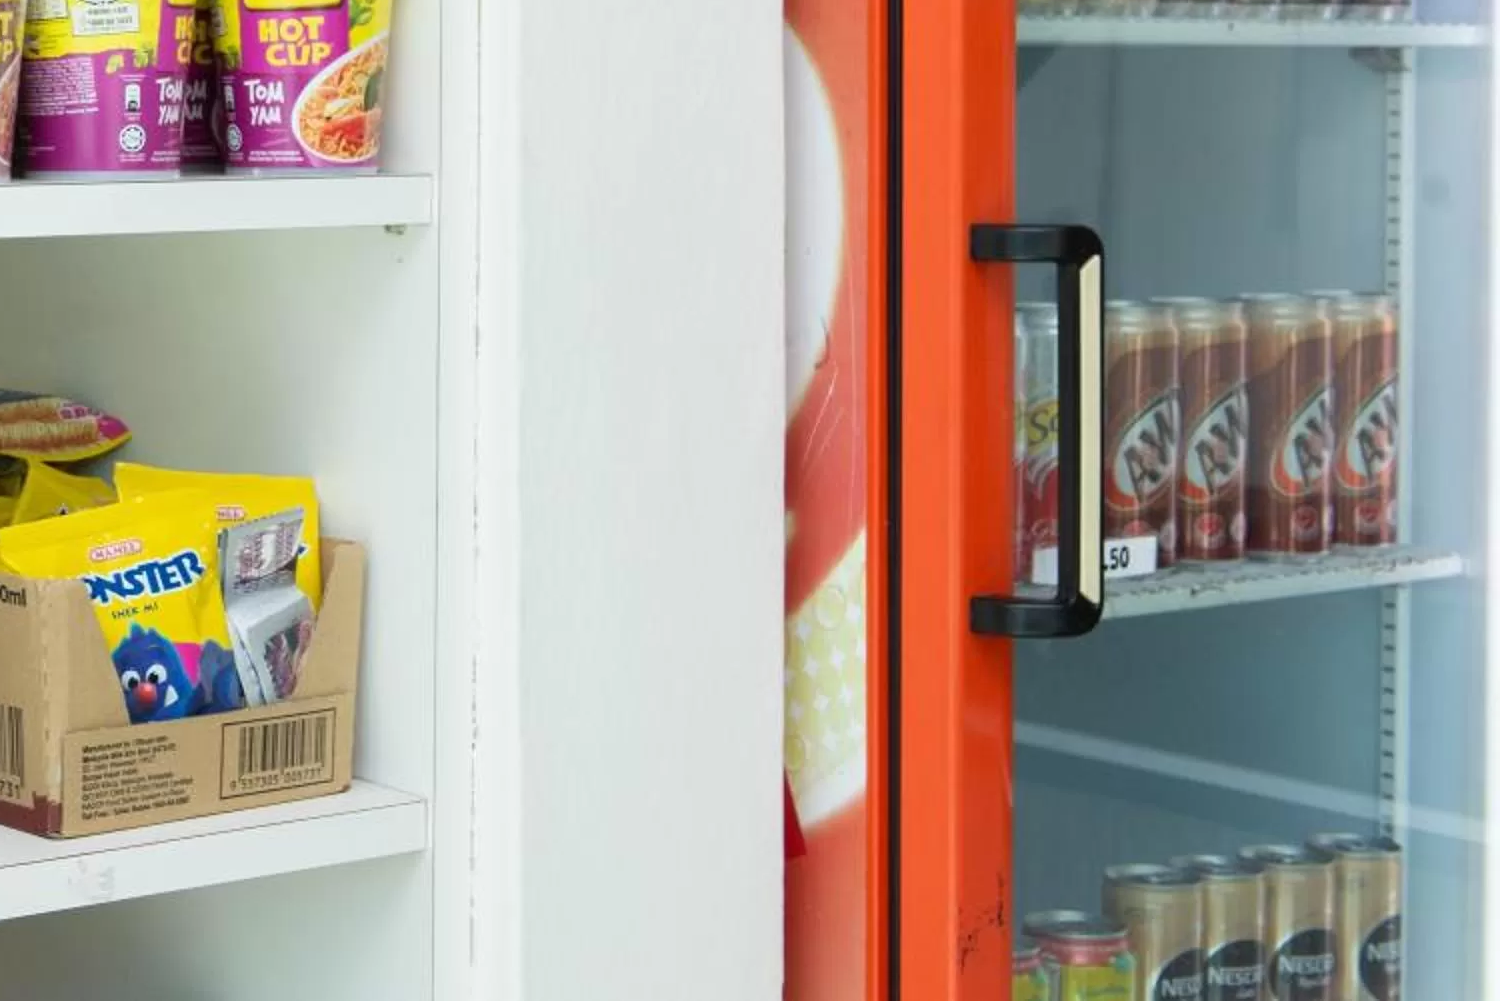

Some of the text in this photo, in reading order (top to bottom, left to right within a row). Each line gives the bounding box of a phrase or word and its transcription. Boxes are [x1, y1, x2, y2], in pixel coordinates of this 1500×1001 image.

[257, 15, 325, 44] HOT
[265, 42, 332, 68] CUP
[243, 79, 285, 105] TOM
[250, 107, 282, 127] YAM
[1102, 545, 1131, 571] .50
